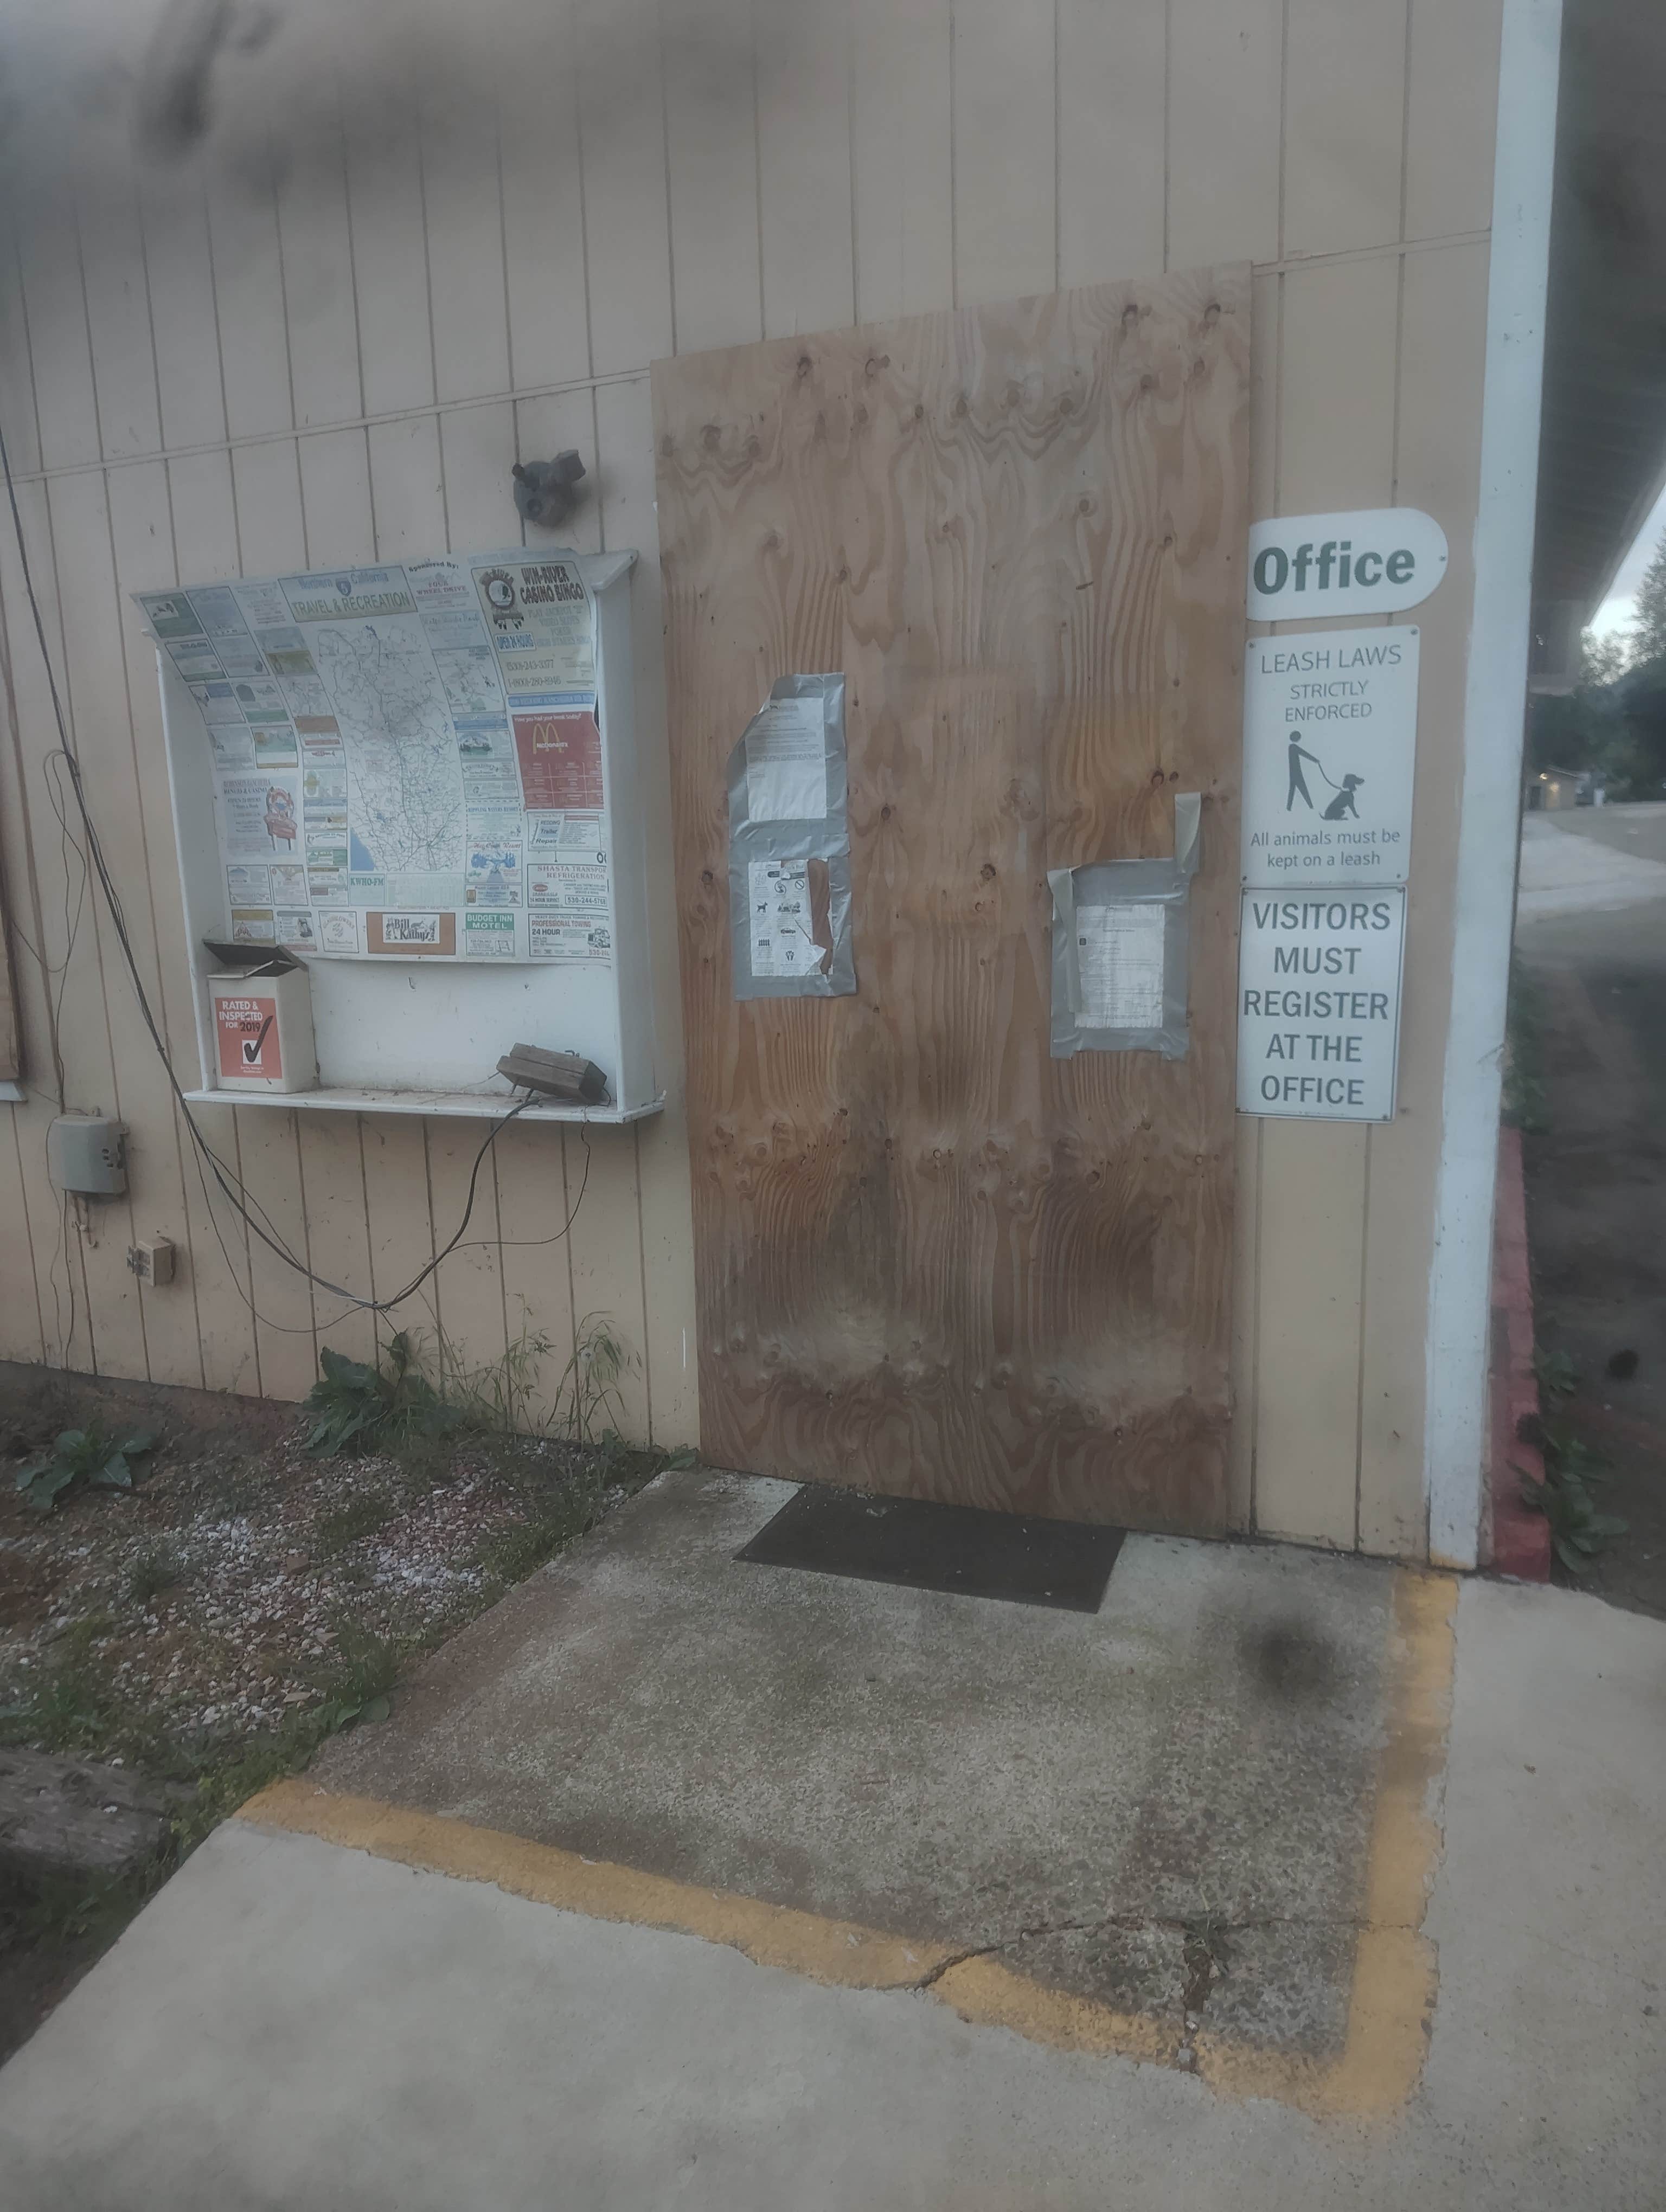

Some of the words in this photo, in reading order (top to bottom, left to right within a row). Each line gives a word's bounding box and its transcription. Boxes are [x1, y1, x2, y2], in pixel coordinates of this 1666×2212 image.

[1254, 541, 1415, 595] Office
[520, 585, 555, 605] CASINO
[554, 582, 584, 602] BINGO
[292, 599, 332, 616] TRAVEL
[334, 598, 341, 612] &
[342, 591, 410, 612] RECREATION
[1261, 650, 1330, 674] LEASH
[1338, 645, 1402, 668] LAWS
[1290, 679, 1369, 700] STRICTLY
[1285, 703, 1372, 722] ENFORCED
[1251, 832, 1268, 846] All
[1274, 830, 1331, 846] animals
[1337, 831, 1377, 844] must
[1383, 828, 1401, 844] be
[1267, 853, 1298, 870] kept
[1303, 855, 1322, 867] on
[1327, 854, 1335, 866] a
[1341, 851, 1381, 866] leash
[547, 872, 605, 880] REFRIGERATION
[394, 918, 410, 929] Bill
[467, 914, 497, 922] BUDGET
[531, 919, 571, 928] PROFESSIONAL
[1253, 903, 1391, 930] VISITORS
[400, 928, 431, 942] Kathy's
[1274, 947, 1362, 974] MUST
[222, 1001, 251, 1011] RATED
[252, 1001, 259, 1011] &
[1244, 989, 1389, 1020] REGISTER
[219, 1011, 263, 1021] INSPECTED
[239, 1021, 261, 1032] 2019
[1265, 1033, 1300, 1059] AT
[1306, 1034, 1362, 1062] THE
[1261, 1075, 1364, 1105] OFFICE
